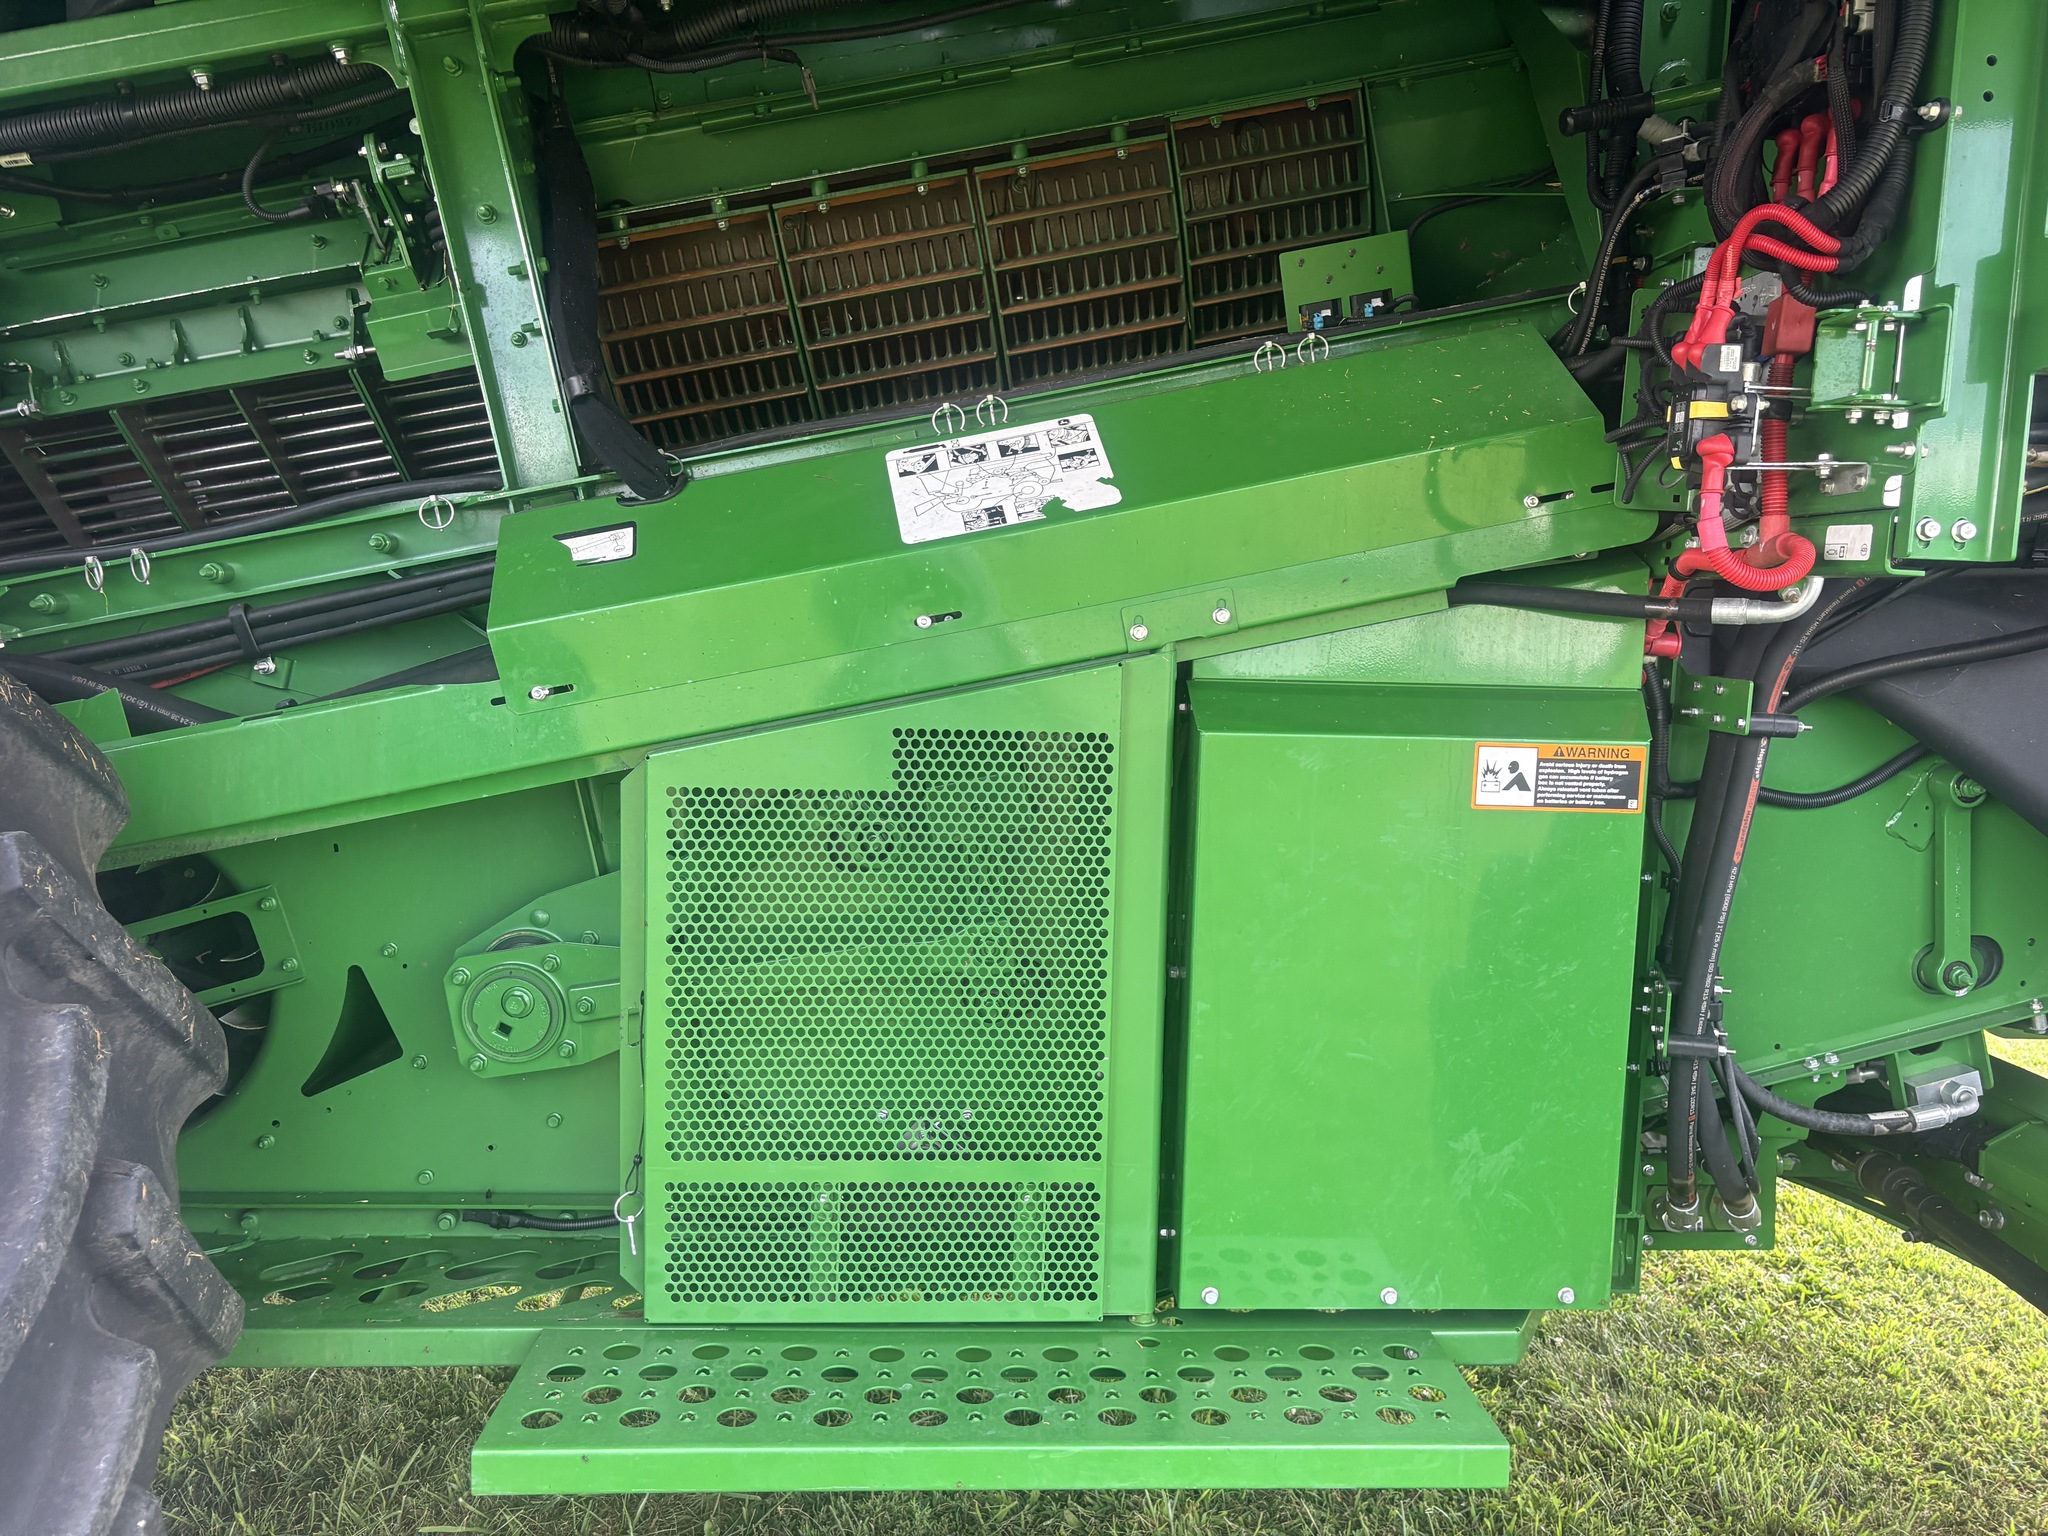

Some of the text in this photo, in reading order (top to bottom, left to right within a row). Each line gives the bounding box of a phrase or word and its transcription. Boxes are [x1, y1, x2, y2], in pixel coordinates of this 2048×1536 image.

[1841, 586, 1856, 600] Flame
[1819, 598, 1840, 622] Resistant
[70, 673, 87, 684] USA
[86, 679, 96, 687] IN
[156, 706, 171, 716] mm
[170, 712, 180, 721] 38
[1565, 746, 1629, 758] WARNING
